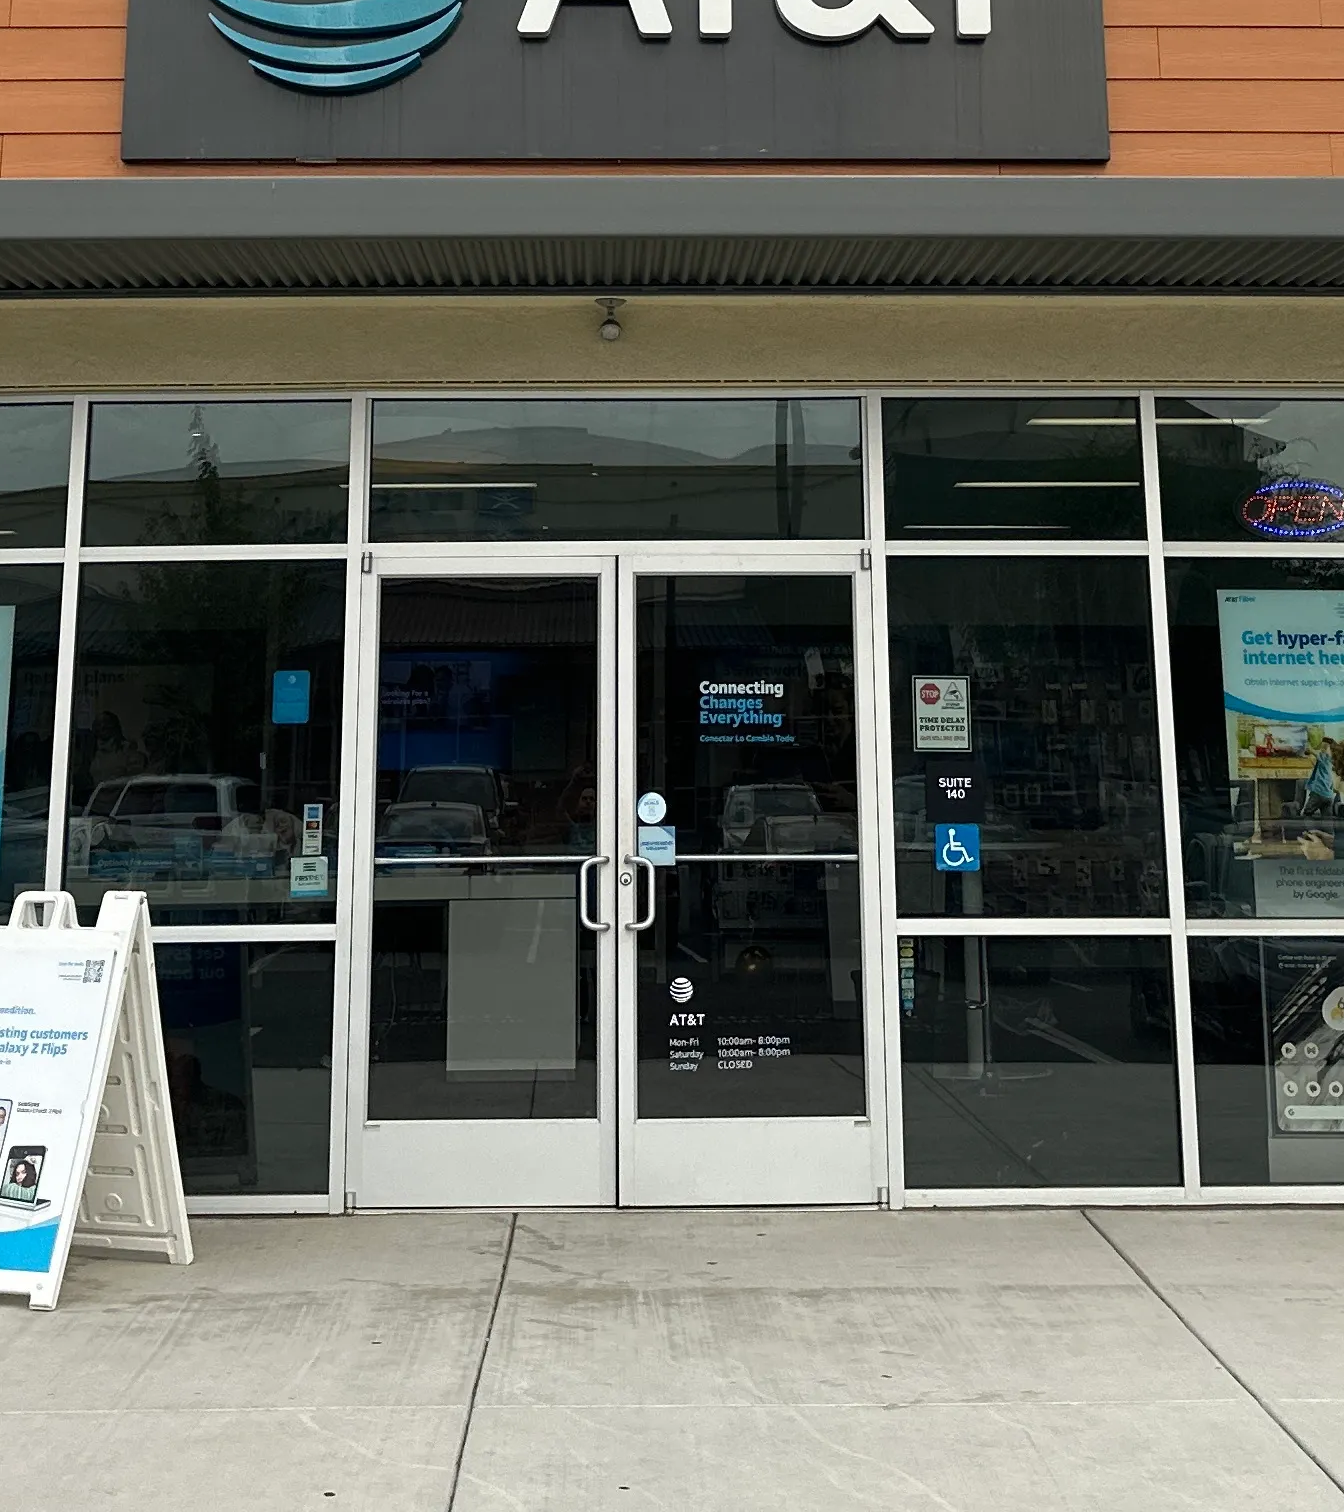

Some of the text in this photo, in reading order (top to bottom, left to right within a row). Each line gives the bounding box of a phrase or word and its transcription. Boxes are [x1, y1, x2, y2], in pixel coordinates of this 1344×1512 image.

[1241, 630, 1273, 646] Get
[1243, 649, 1316, 665] internet
[699, 679, 785, 698] Connecting
[921, 689, 939, 699] STOP
[699, 695, 764, 712] Changes
[699, 710, 784, 728] Everything
[919, 724, 966, 732] PROTECTED
[938, 777, 972, 788] SUITE
[945, 789, 966, 799] 140
[1279, 866, 1294, 875] The
[1275, 878, 1304, 888] phone
[1292, 890, 1305, 899] by
[669, 1013, 706, 1027] AT&T
[30, 1028, 89, 1041] customers
[669, 1037, 700, 1047] Mon-Fri
[31, 1043, 40, 1054] Z
[41, 1043, 69, 1057] Flip5
[669, 1049, 705, 1060] Saturday
[669, 1059, 754, 1072] Sunday CLOSED
